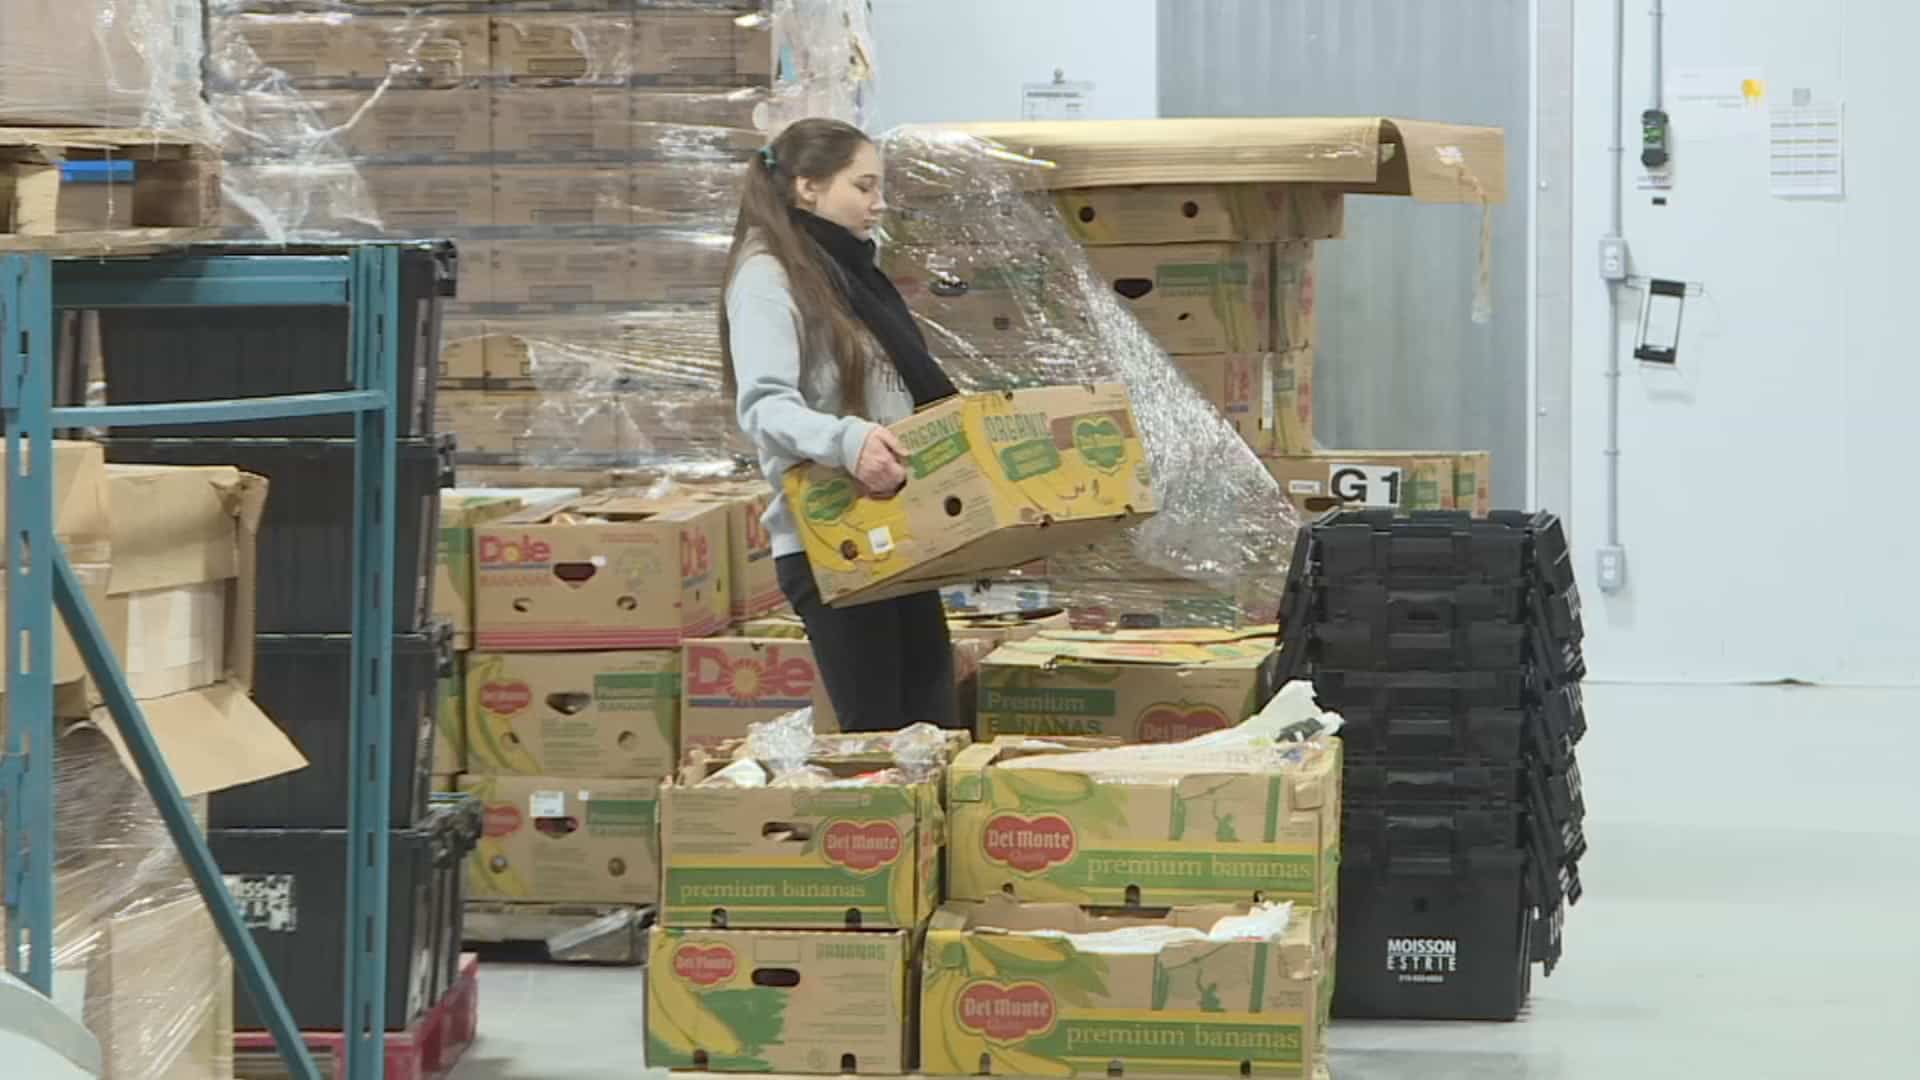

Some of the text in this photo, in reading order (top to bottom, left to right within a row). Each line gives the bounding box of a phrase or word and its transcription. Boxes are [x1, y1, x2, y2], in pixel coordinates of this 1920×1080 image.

[1331, 468, 1400, 504] G 1
[479, 534, 552, 562] Dole
[687, 644, 816, 704] Dole
[990, 688, 1085, 713] Premium
[827, 833, 898, 850] Del Monte
[987, 828, 1071, 849] Del Monte
[1088, 854, 1313, 880] premium bananas
[680, 879, 866, 903] premium bananas
[1387, 938, 1457, 954] MOISSON
[1387, 956, 1457, 972] ESTRIE
[965, 997, 1050, 1019] Del Monte
[1067, 1023, 1298, 1050] premium bananas
